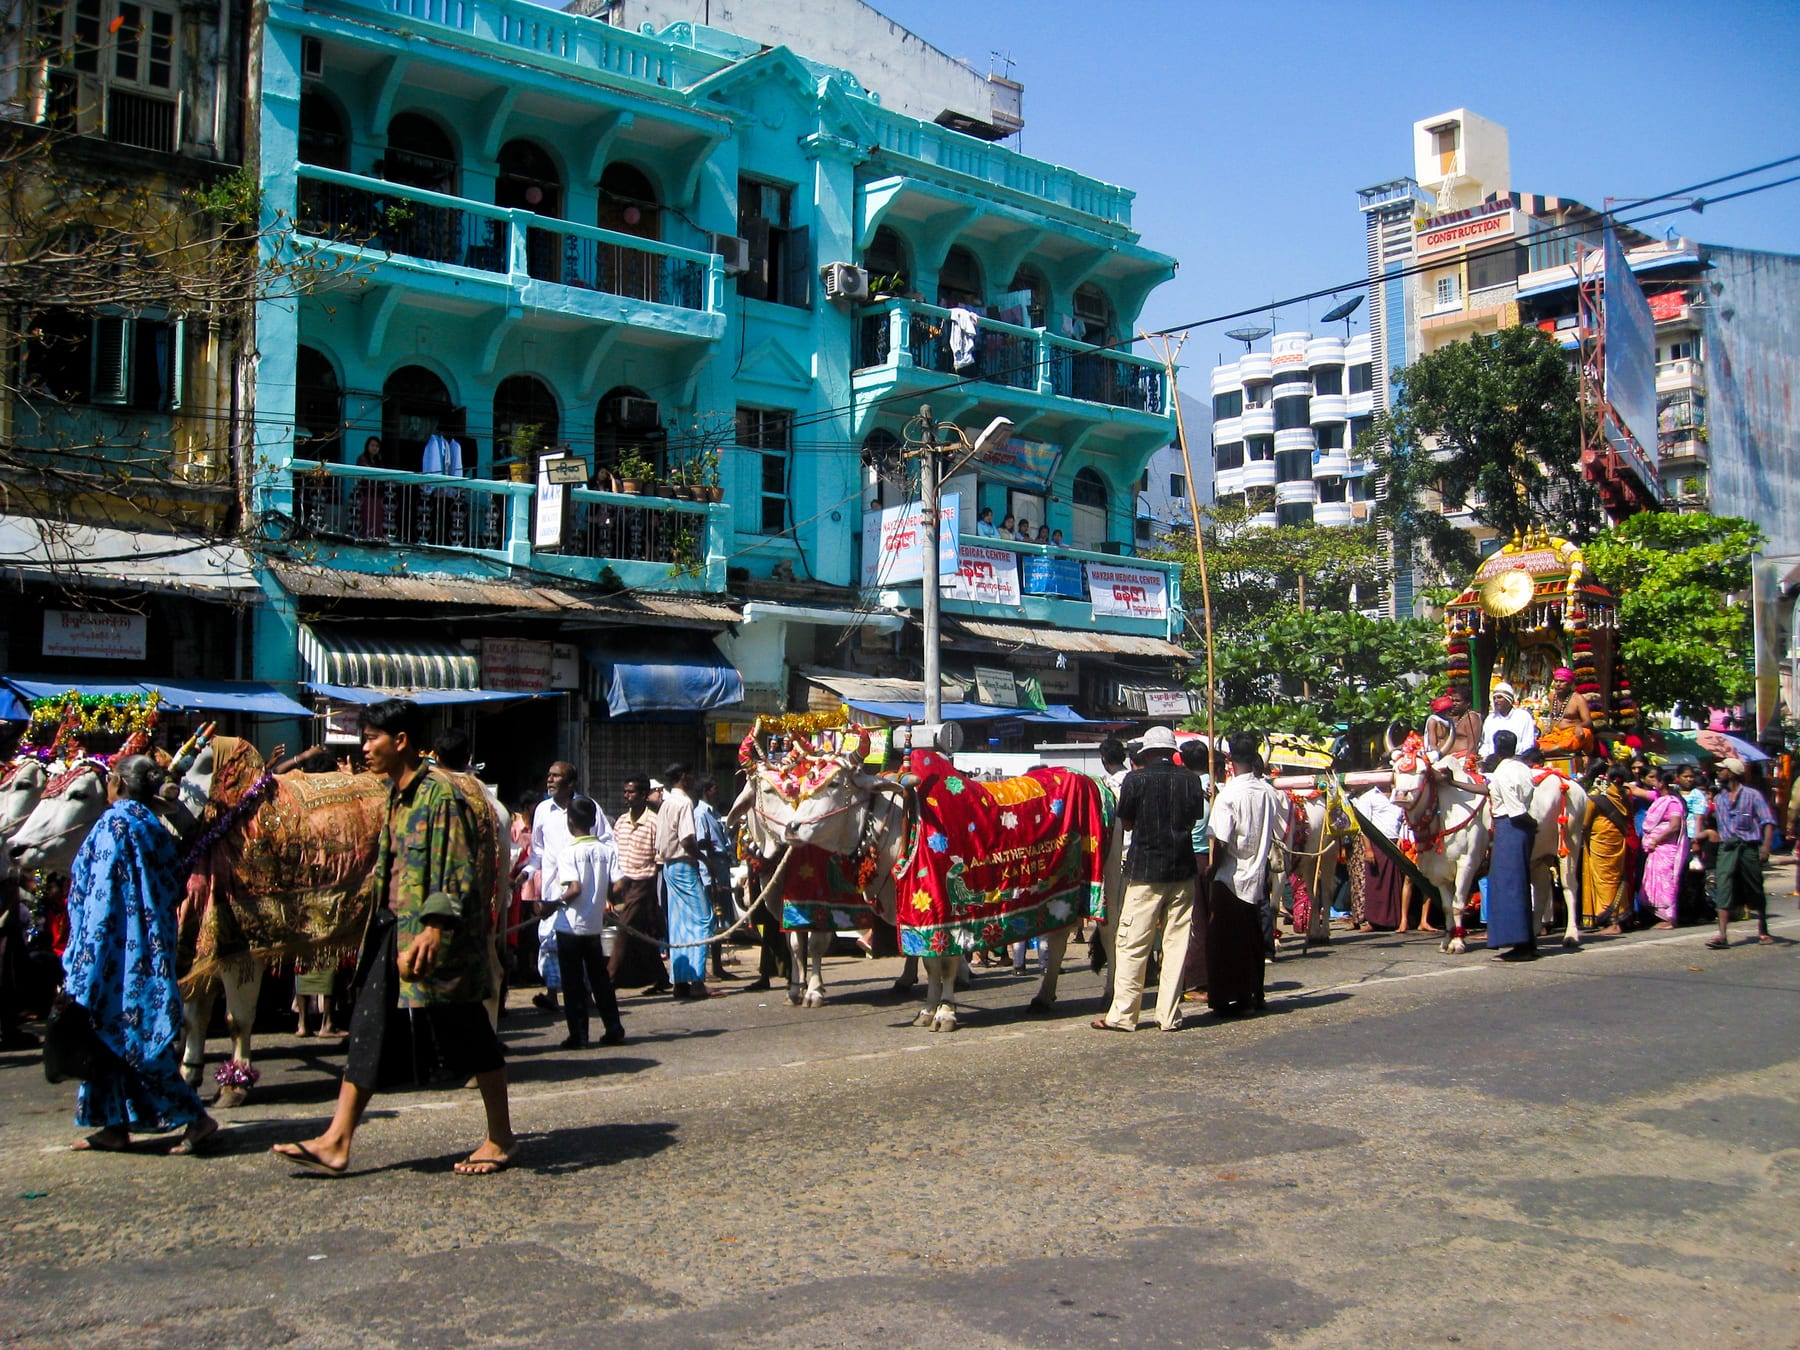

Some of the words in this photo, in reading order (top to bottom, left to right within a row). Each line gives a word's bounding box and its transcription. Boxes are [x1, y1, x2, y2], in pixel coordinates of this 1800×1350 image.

[1426, 208, 1471, 229] FATHER
[1480, 198, 1512, 215] LAND
[1427, 218, 1501, 246] CONSTRUCTION
[985, 549, 1011, 563] CENTRE
[1092, 570, 1115, 582] NAYZAR
[1115, 573, 1139, 584] MEDICAL
[1139, 575, 1161, 586] CENTRE
[1001, 859, 1046, 880] KANBE
